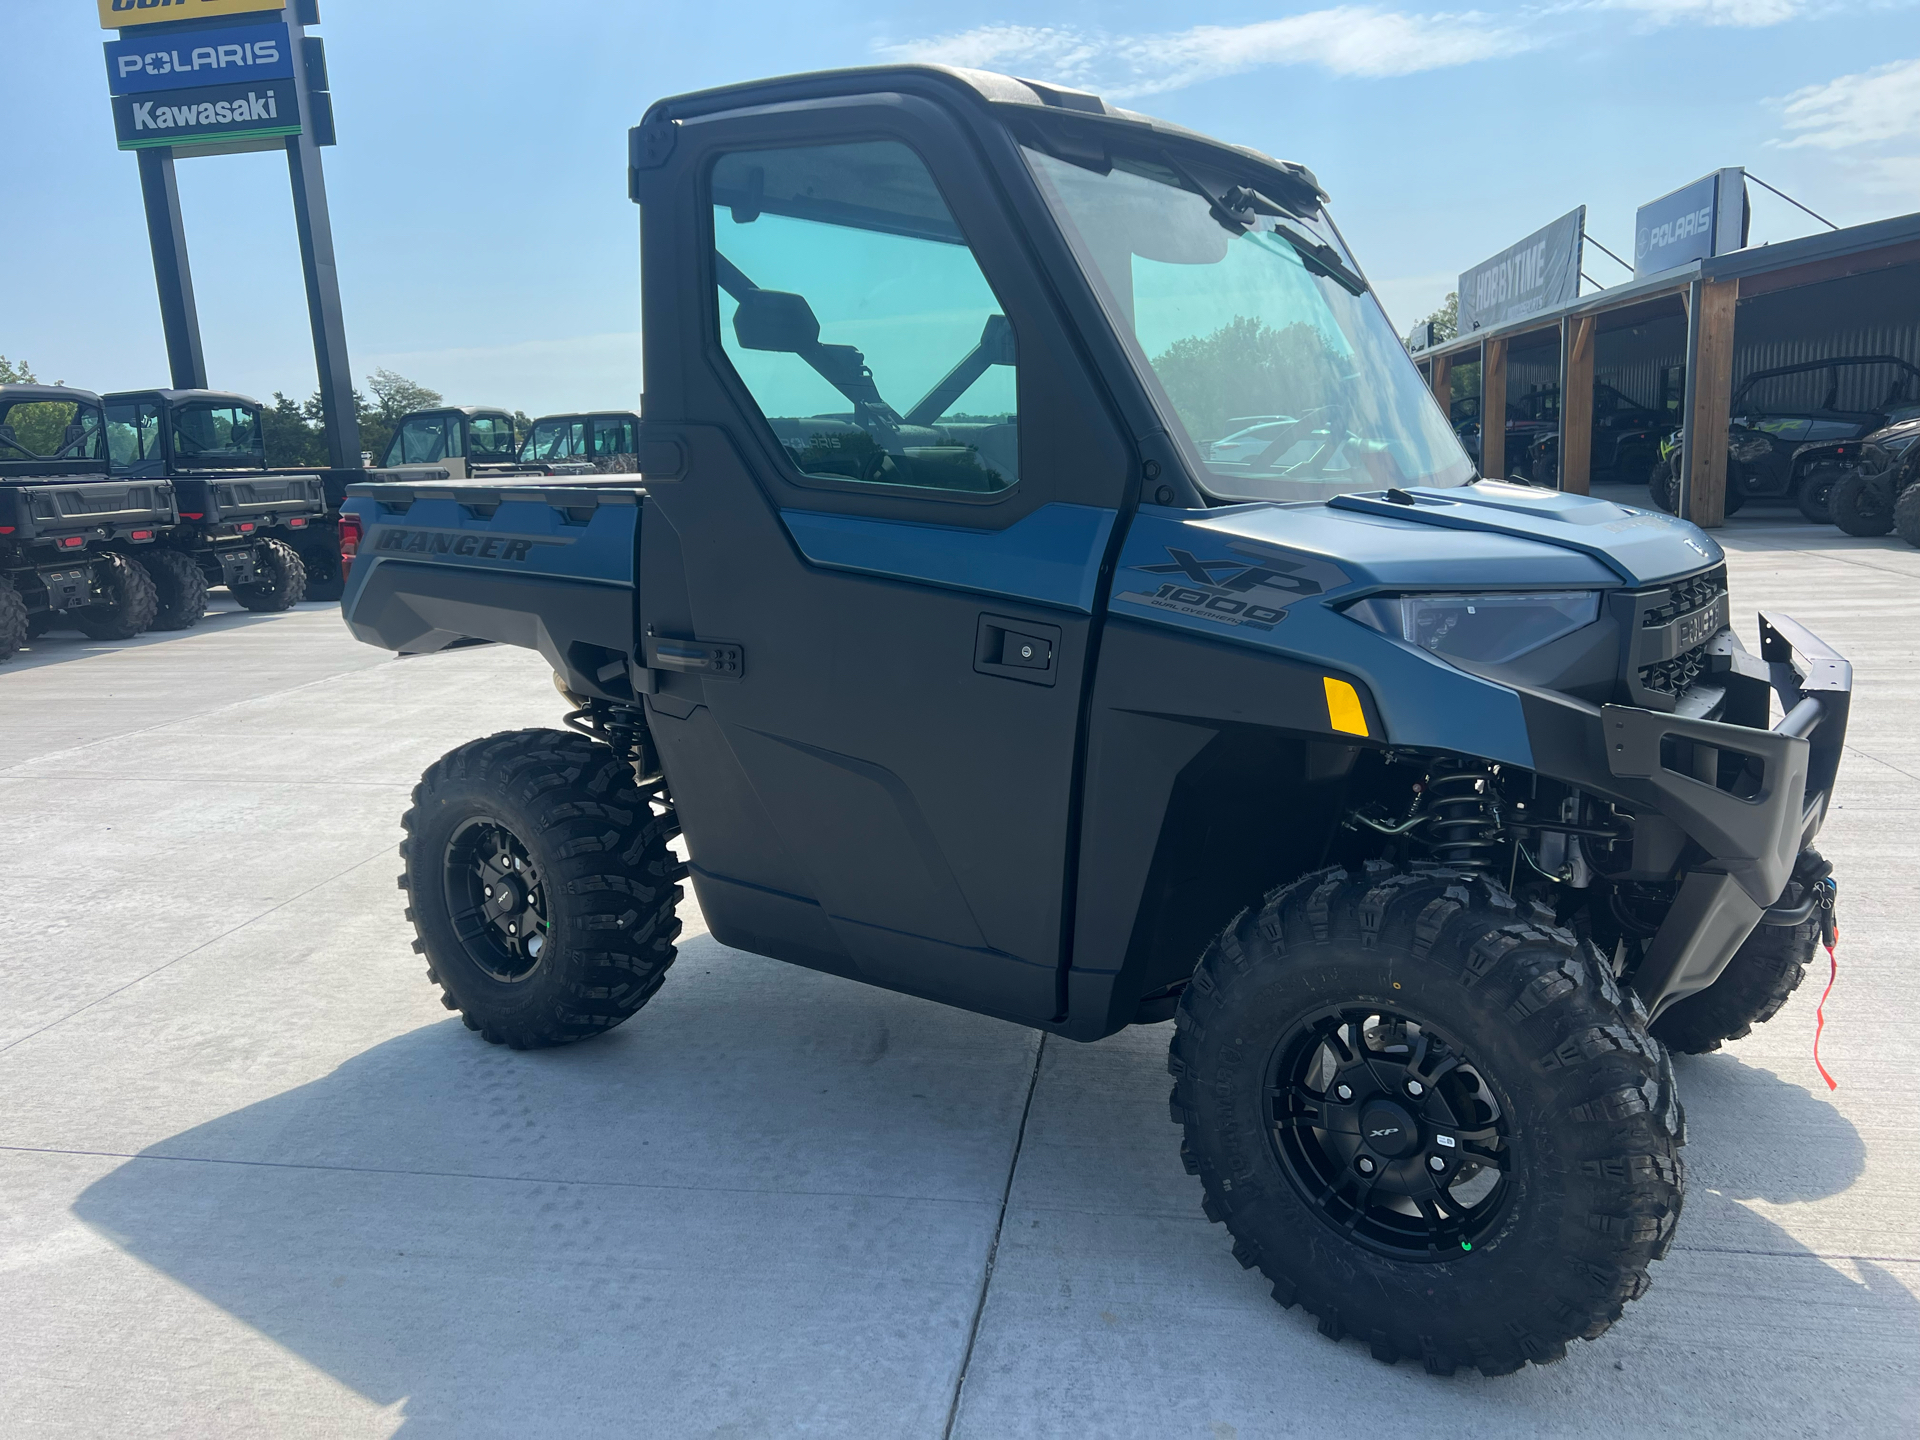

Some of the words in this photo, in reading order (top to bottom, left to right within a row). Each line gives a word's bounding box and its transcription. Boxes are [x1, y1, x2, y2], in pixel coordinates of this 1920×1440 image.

[117, 40, 280, 78] POLARIS
[132, 89, 278, 130] Kawasaki
[1649, 207, 1710, 251] POLARIS
[1475, 240, 1546, 312] HOBBYTIME
[1507, 294, 1544, 318] SPORTS
[780, 437, 842, 449] POLARIS
[381, 528, 534, 562] RANGER
[1126, 545, 1326, 595] XP
[1150, 599, 1179, 611] DUAL
[1180, 606, 1244, 625] OVERHEAD
[1152, 583, 1290, 626] 1000
[1368, 1126, 1400, 1139] XP
